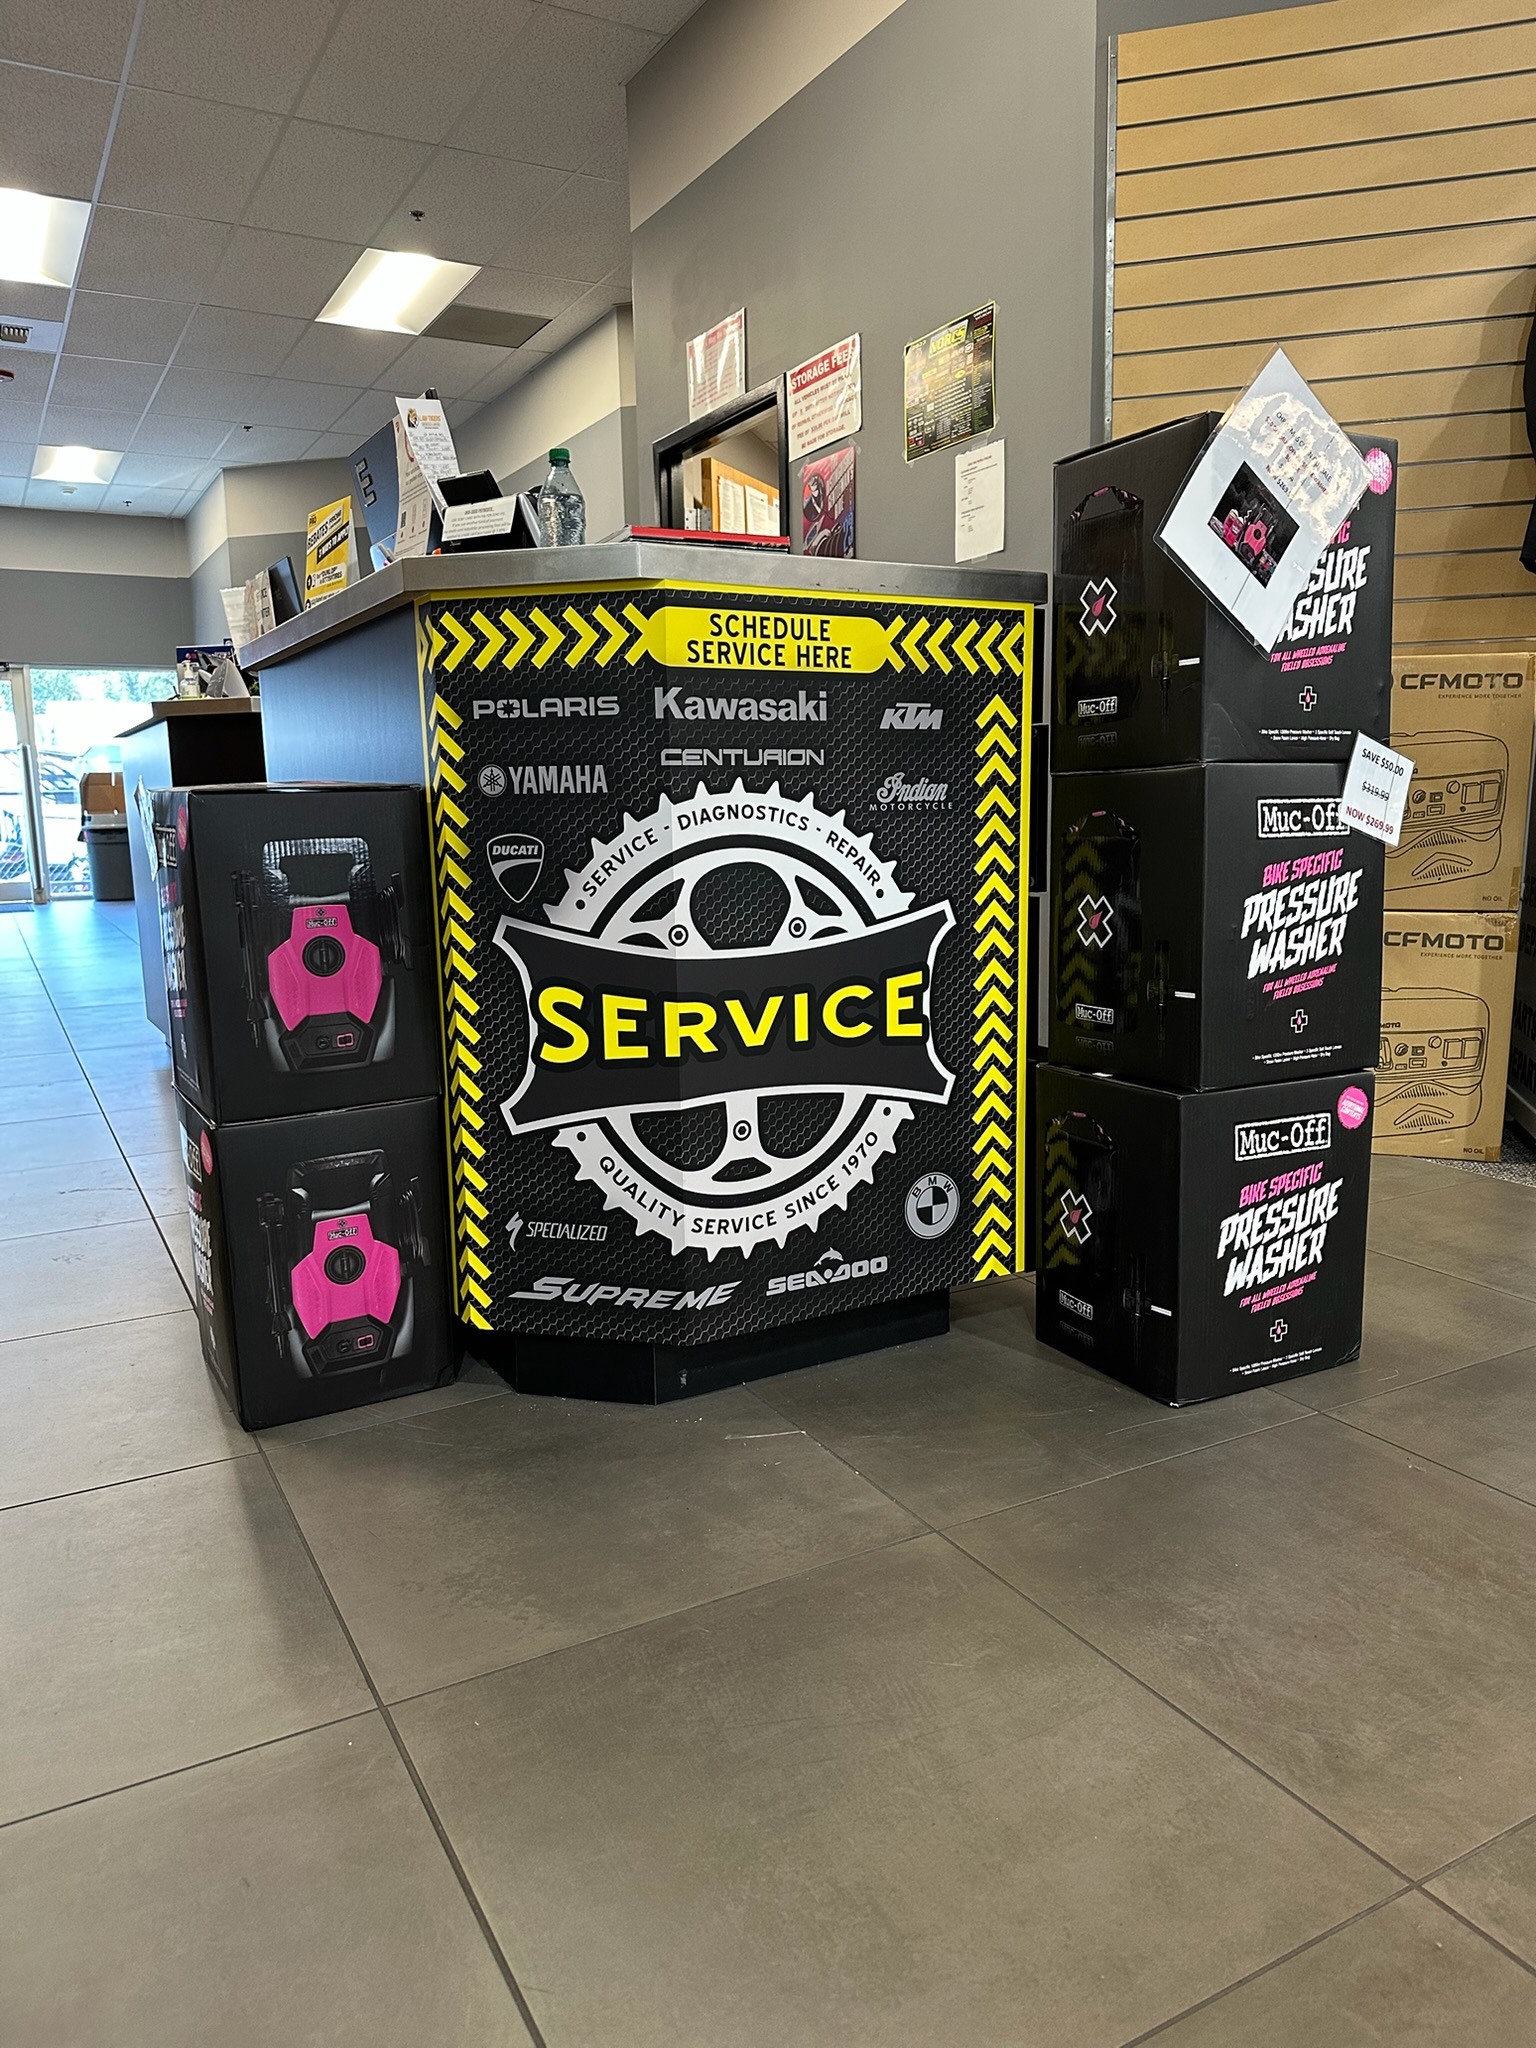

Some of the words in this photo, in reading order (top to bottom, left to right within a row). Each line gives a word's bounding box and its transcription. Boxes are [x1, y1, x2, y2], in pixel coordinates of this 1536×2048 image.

[791, 358, 830, 389] STORAGE
[710, 613, 831, 642] SCHEDULE
[1277, 591, 1357, 643] ASHER
[687, 640, 786, 667] SERVICE
[796, 645, 852, 669] HERE
[1282, 650, 1292, 661] ALL
[1400, 672, 1523, 690] CFMOTO
[473, 696, 620, 719] POLARIS
[654, 687, 827, 722] Kawasaki
[880, 702, 943, 730] KTM
[1080, 699, 1115, 715] Muc-Off
[660, 748, 824, 766] CENTURION
[1362, 748, 1380, 765] SAVE
[1380, 757, 1404, 777] $50.00
[509, 765, 608, 794] YAMAHA
[876, 772, 949, 803] Indian
[869, 802, 953, 811] MOTORCYCLE
[1346, 805, 1365, 822] NOW
[1366, 815, 1394, 835] $269.99
[492, 844, 539, 856] DUCATI
[582, 828, 659, 897] SERVICE
[677, 804, 809, 831] DIAGNOSTICS
[826, 830, 881, 887] REPAIR
[1262, 861, 1290, 888] BIKE
[1290, 848, 1344, 881] SPECIFIC
[1241, 868, 1363, 940] PRESSURE
[1247, 914, 1348, 980] WASHER
[1384, 931, 1504, 951] CFMOTO
[538, 970, 923, 1064] SERVICE
[1077, 1006, 1111, 1022] Muc-Off
[1240, 1118, 1328, 1155] Muc-Off
[599, 1156, 686, 1228] QUALITY
[691, 1210, 777, 1235] SERVICE
[784, 1174, 841, 1219] SINCE
[841, 1131, 878, 1176] 1970
[911, 1176, 954, 1199] BMW
[1239, 1179, 1268, 1208] BIKE
[1268, 1161, 1324, 1200] SPECIFIC
[526, 1221, 608, 1241] SPECIALIZED
[1216, 1177, 1344, 1259] PRESSURE
[1223, 1222, 1327, 1297] WASHER
[508, 1276, 743, 1311] SUPREME
[1061, 1293, 1091, 1318] Muc-Off
